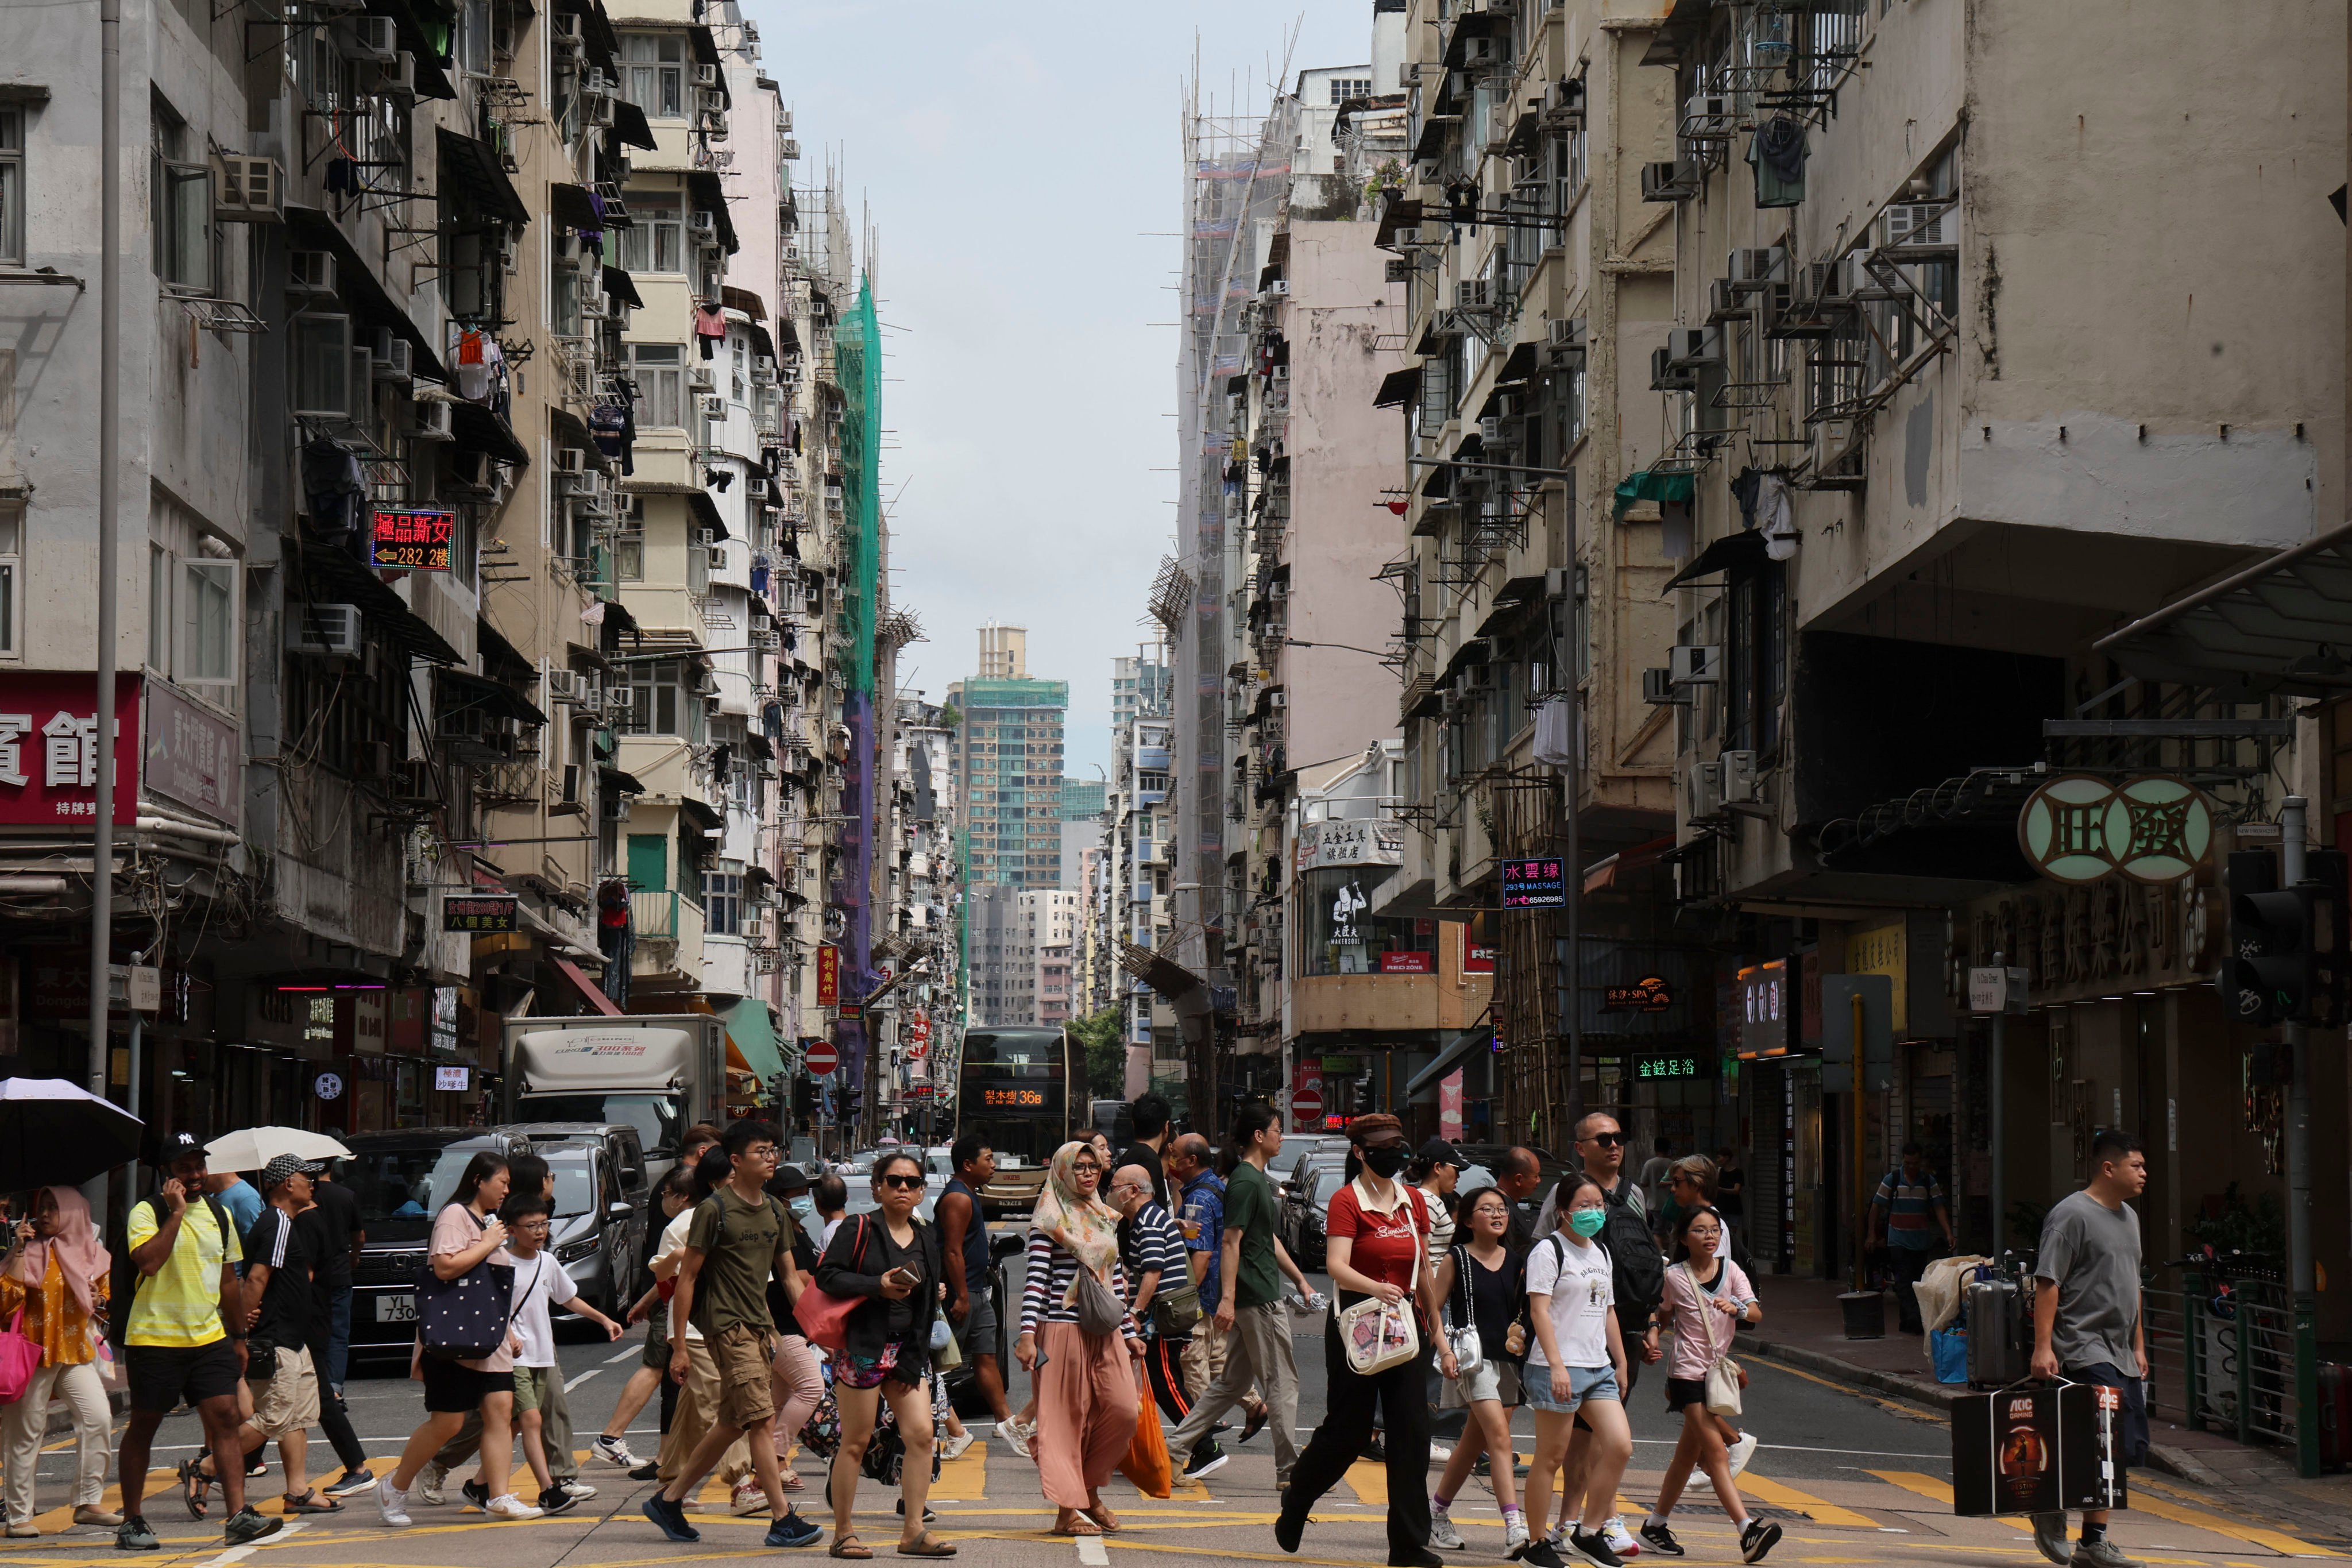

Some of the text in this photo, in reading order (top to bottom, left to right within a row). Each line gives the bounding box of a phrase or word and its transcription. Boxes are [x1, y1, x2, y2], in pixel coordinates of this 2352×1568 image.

[376, 513, 450, 543] 極品新女
[398, 547, 423, 565] 282
[2052, 801, 2186, 856] 旺發
[1323, 829, 1366, 845] 五金工具
[1327, 845, 1359, 860] 旗艦店
[1527, 882, 1562, 890] MASSAGE
[1505, 897, 1519, 905] 2/F
[451, 916, 508, 928] 八個美女
[1334, 925, 1358, 937] 大匠夫
[822, 948, 834, 995] 明利腐竹
[443, 1068, 462, 1078] 極濃
[1639, 1059, 1695, 1076] 金鉉足浴
[984, 1090, 1041, 1104] 梨木樹 36B
[179, 1133, 195, 1145] NY
[739, 1231, 758, 1242] Jeep
[391, 1296, 410, 1308] YL
[385, 1308, 415, 1320] 730
[2010, 1399, 2033, 1412] AOC
